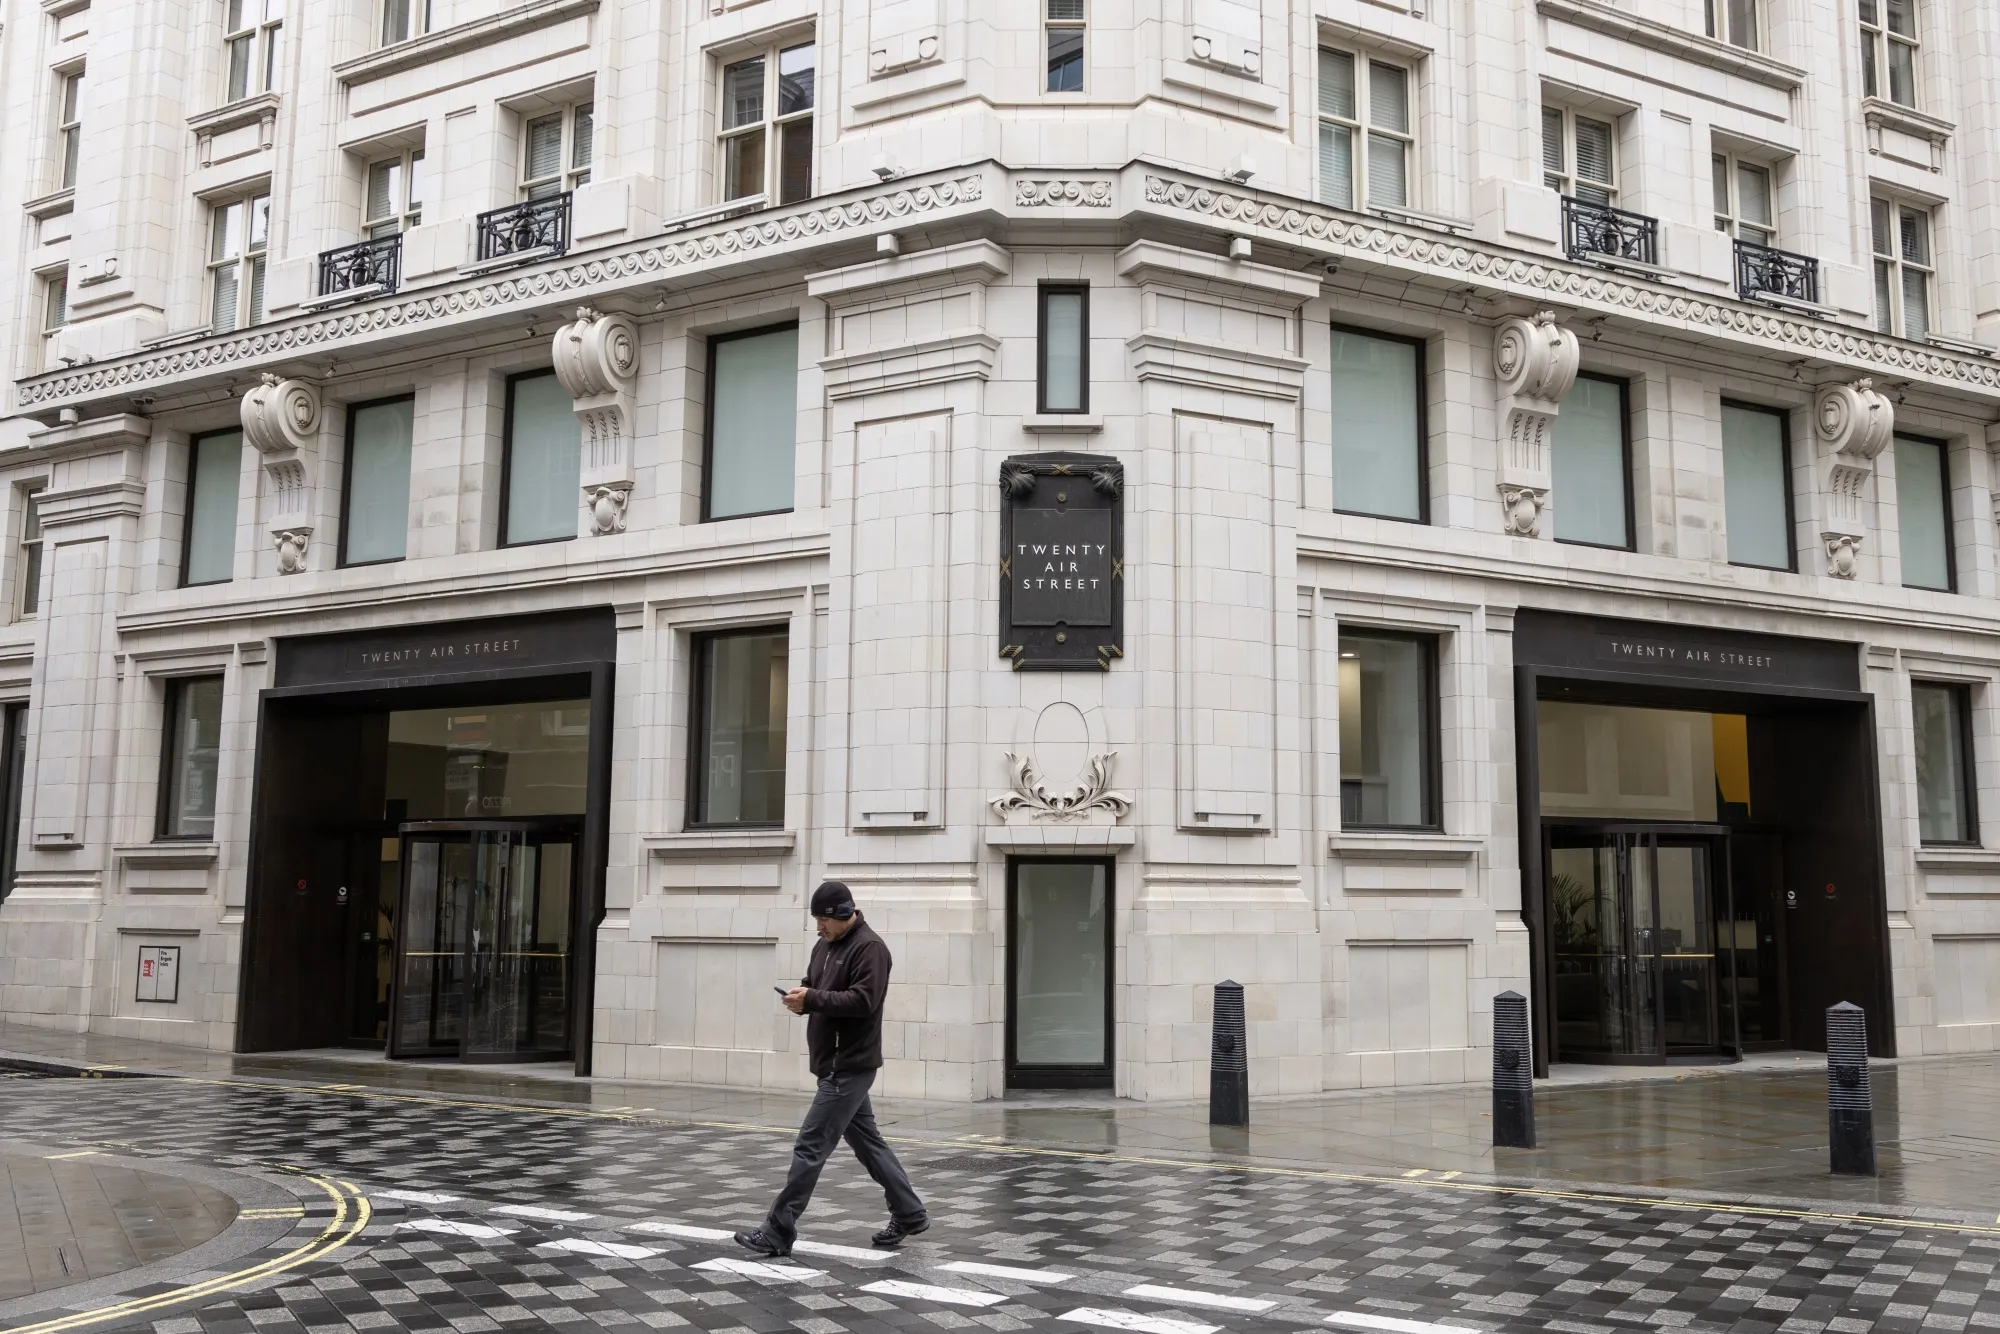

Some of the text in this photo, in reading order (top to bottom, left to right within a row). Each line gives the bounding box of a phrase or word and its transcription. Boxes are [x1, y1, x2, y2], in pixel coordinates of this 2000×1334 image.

[1018, 544, 1105, 555] TWENTY
[1045, 562, 1078, 572] AIR
[1023, 579, 1099, 590] STREET
[362, 640, 520, 663] TWENTY AIR STREET
[1612, 642, 1771, 667] TWENTY AIR STREET
